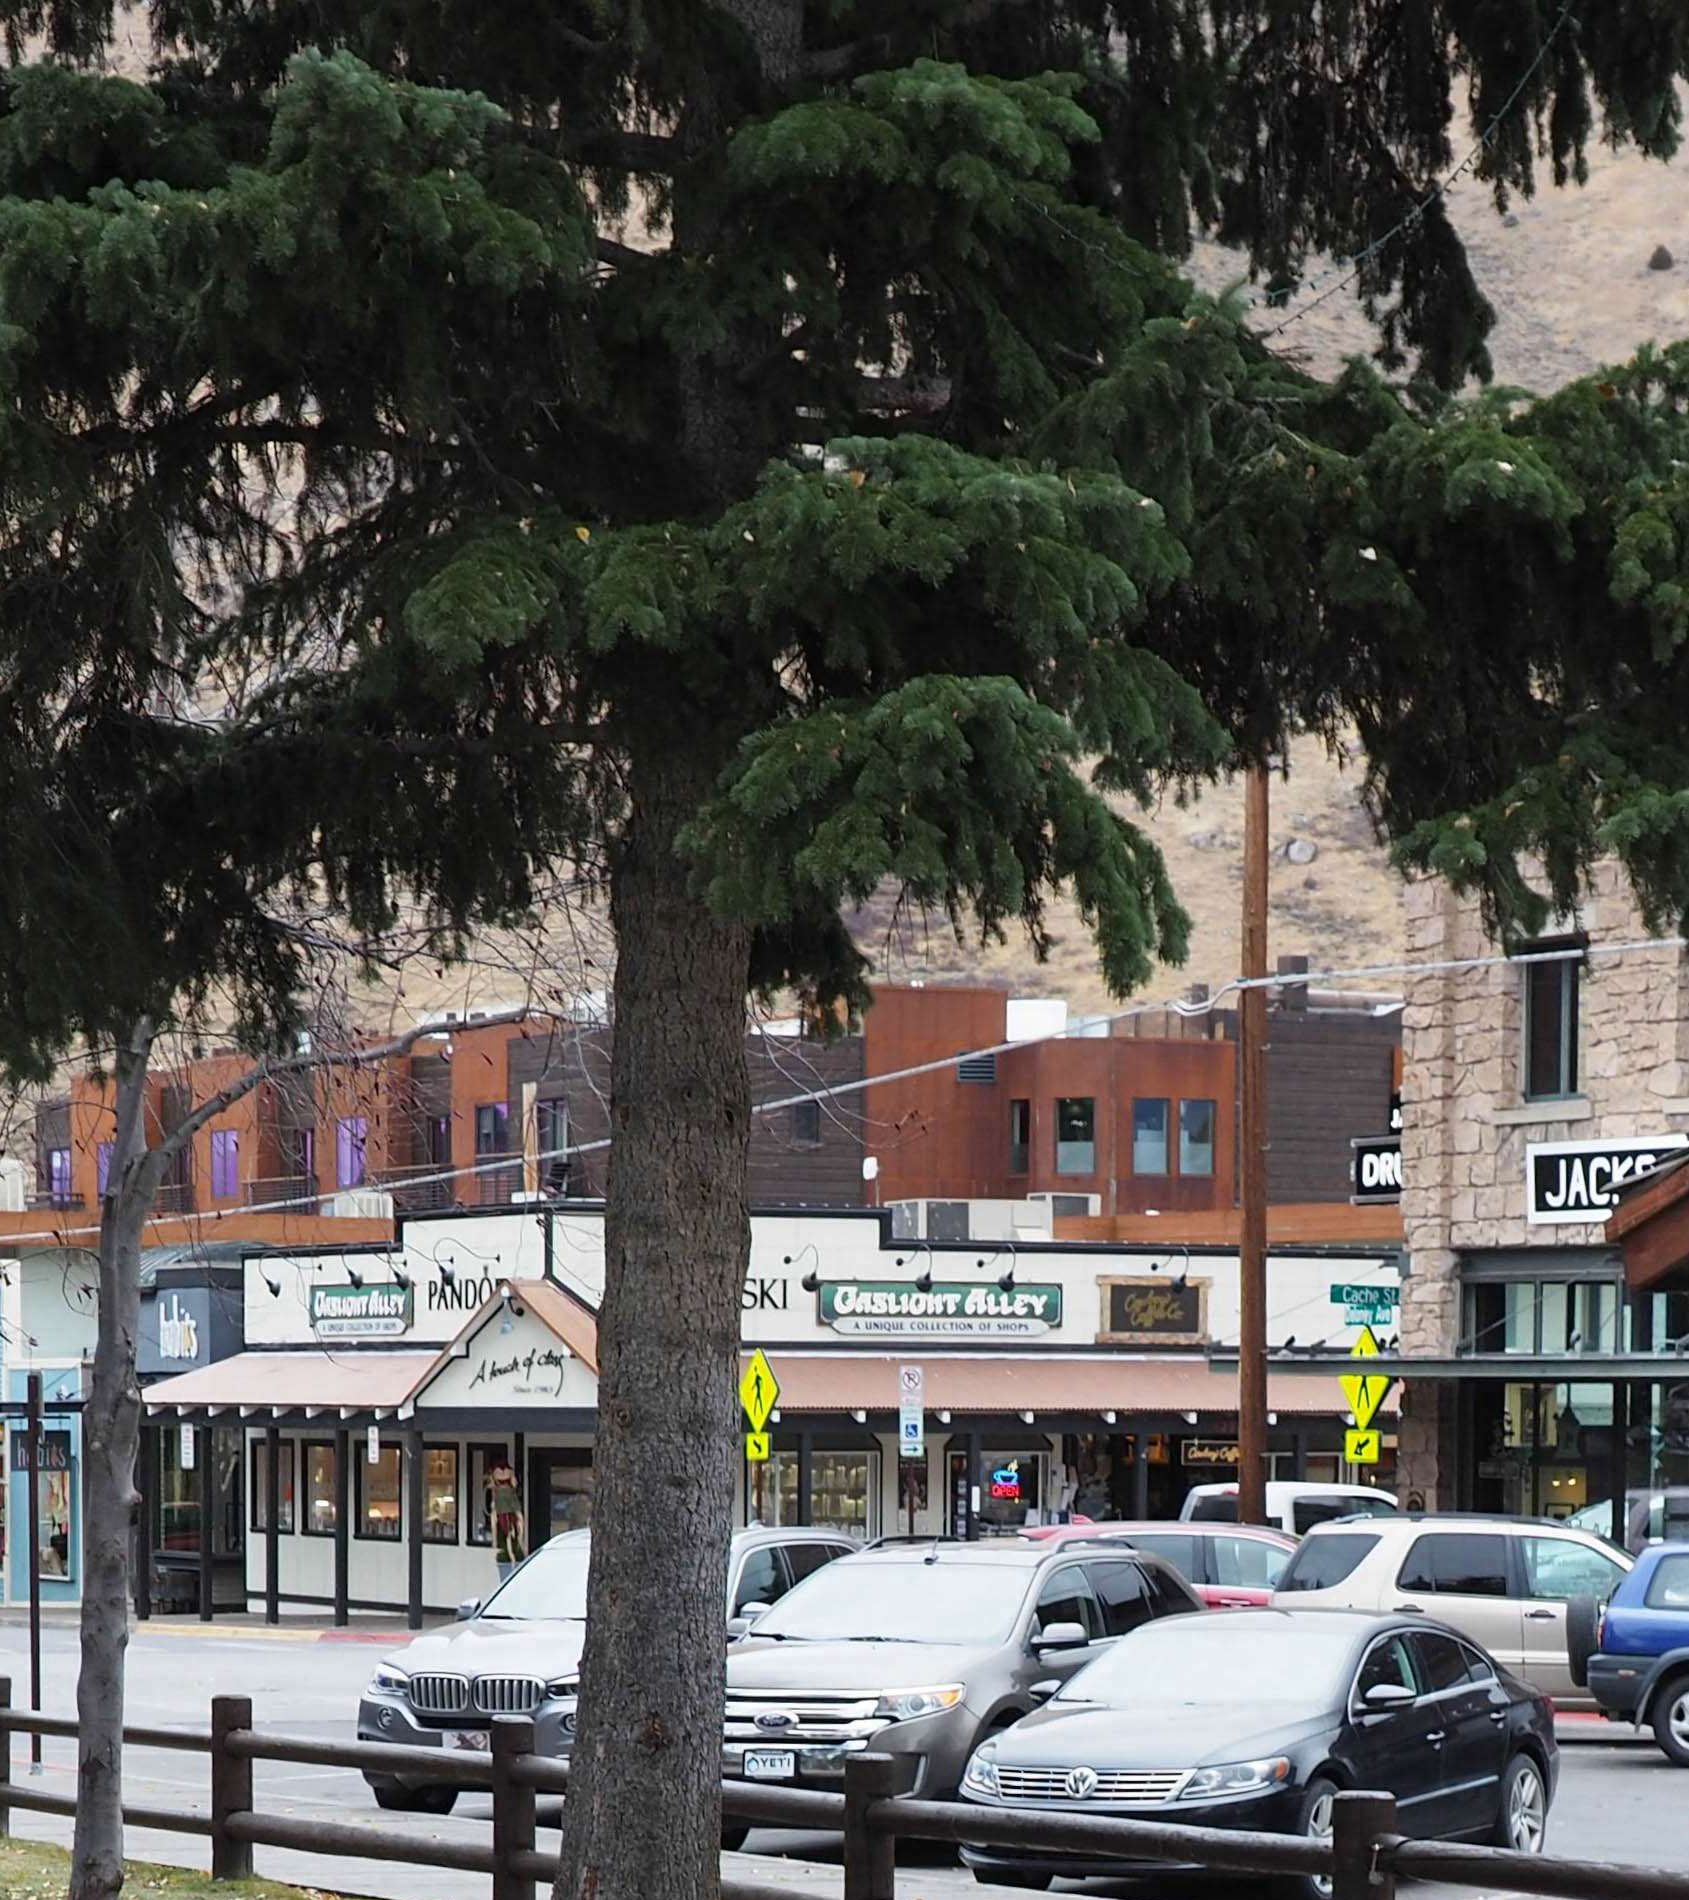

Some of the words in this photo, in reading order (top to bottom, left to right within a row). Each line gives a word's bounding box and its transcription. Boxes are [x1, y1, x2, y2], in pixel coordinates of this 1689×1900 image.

[428, 1277, 509, 1311] PANDO
[1342, 1286, 1380, 1304] Cache
[853, 1321, 861, 1330] A
[865, 1321, 904, 1331] UNIQUE
[909, 1321, 974, 1331] COLLECTION
[979, 1322, 991, 1331] OF
[997, 1322, 1029, 1332] SHOPS
[522, 1348, 537, 1381] of
[17, 1437, 67, 1468] hbits
[992, 1484, 1020, 1498] OPEN
[760, 1757, 791, 1769] YETI
